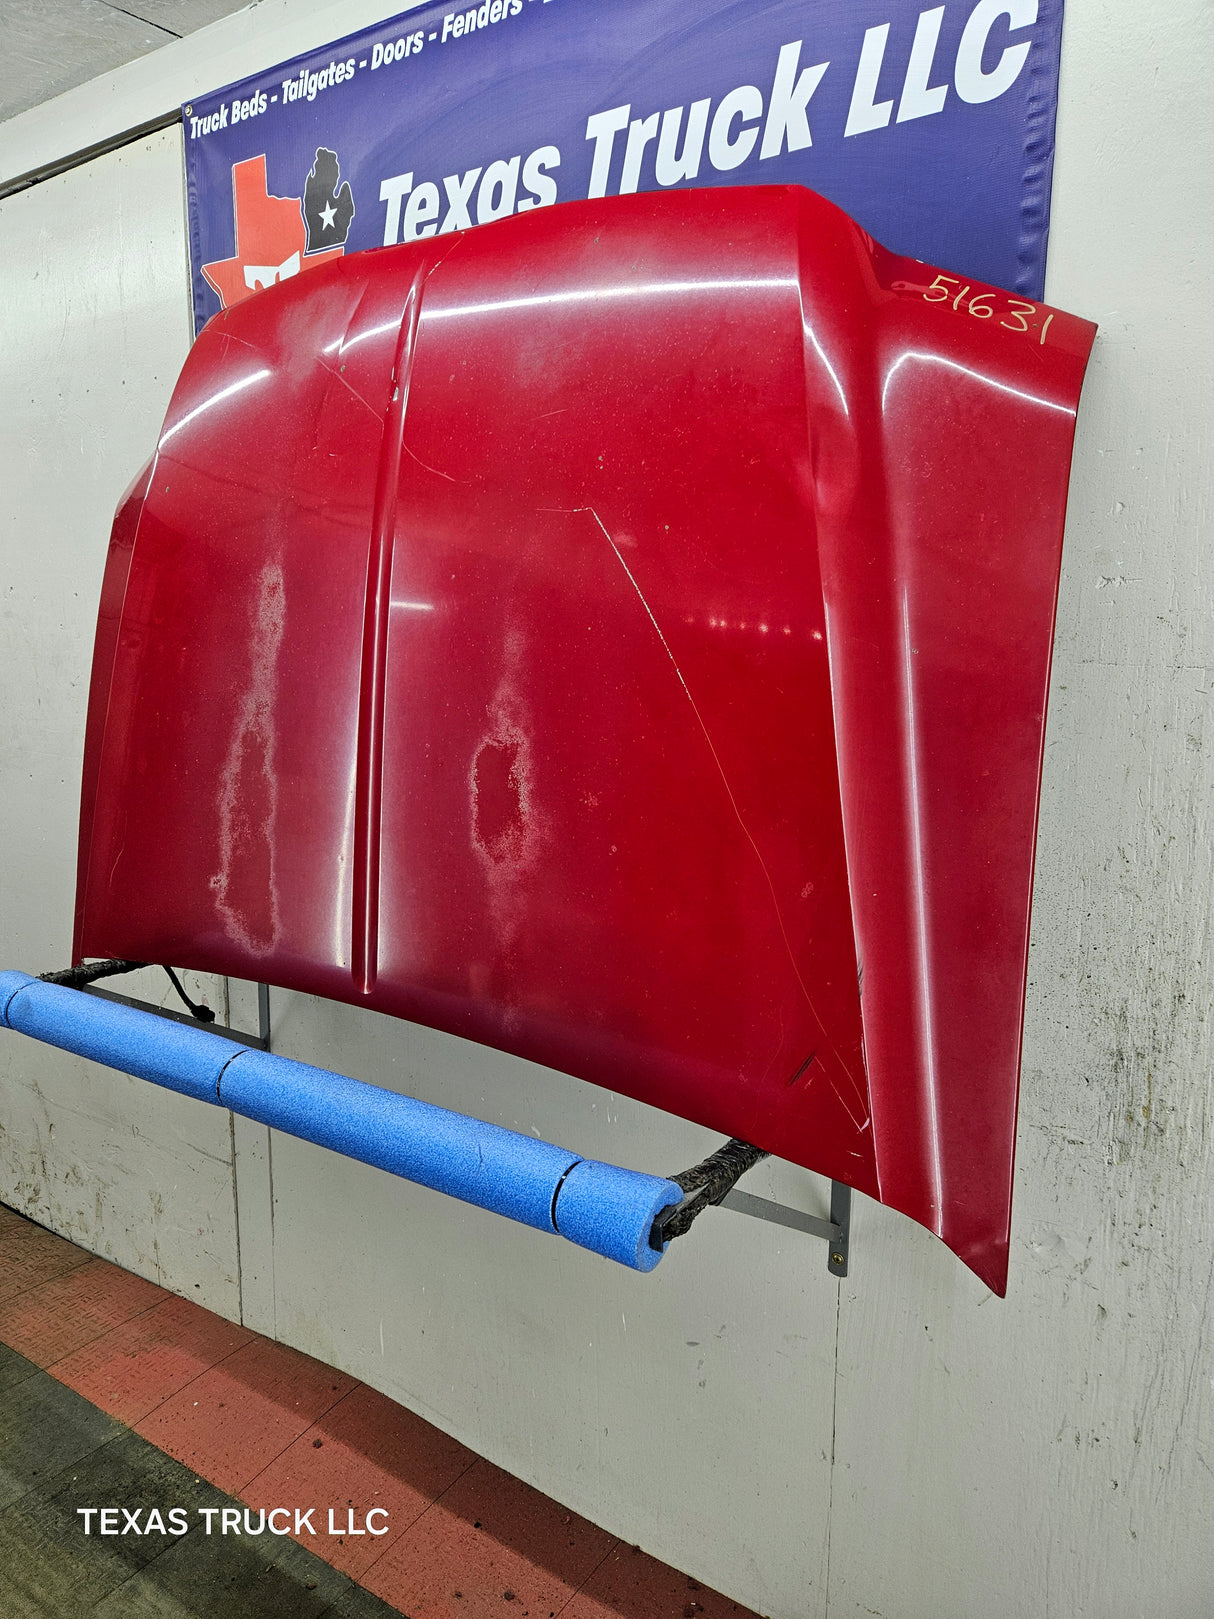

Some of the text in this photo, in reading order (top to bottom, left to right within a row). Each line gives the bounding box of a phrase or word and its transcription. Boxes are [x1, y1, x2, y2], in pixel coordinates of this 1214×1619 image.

[190, 104, 229, 139] Truck
[231, 89, 268, 125] Beds
[282, 58, 355, 104] Tailgates
[371, 31, 424, 70] Doors
[441, 0, 523, 43] Fenders
[379, 0, 1039, 247] Texas Truck LLC
[923, 275, 1054, 345] 51631
